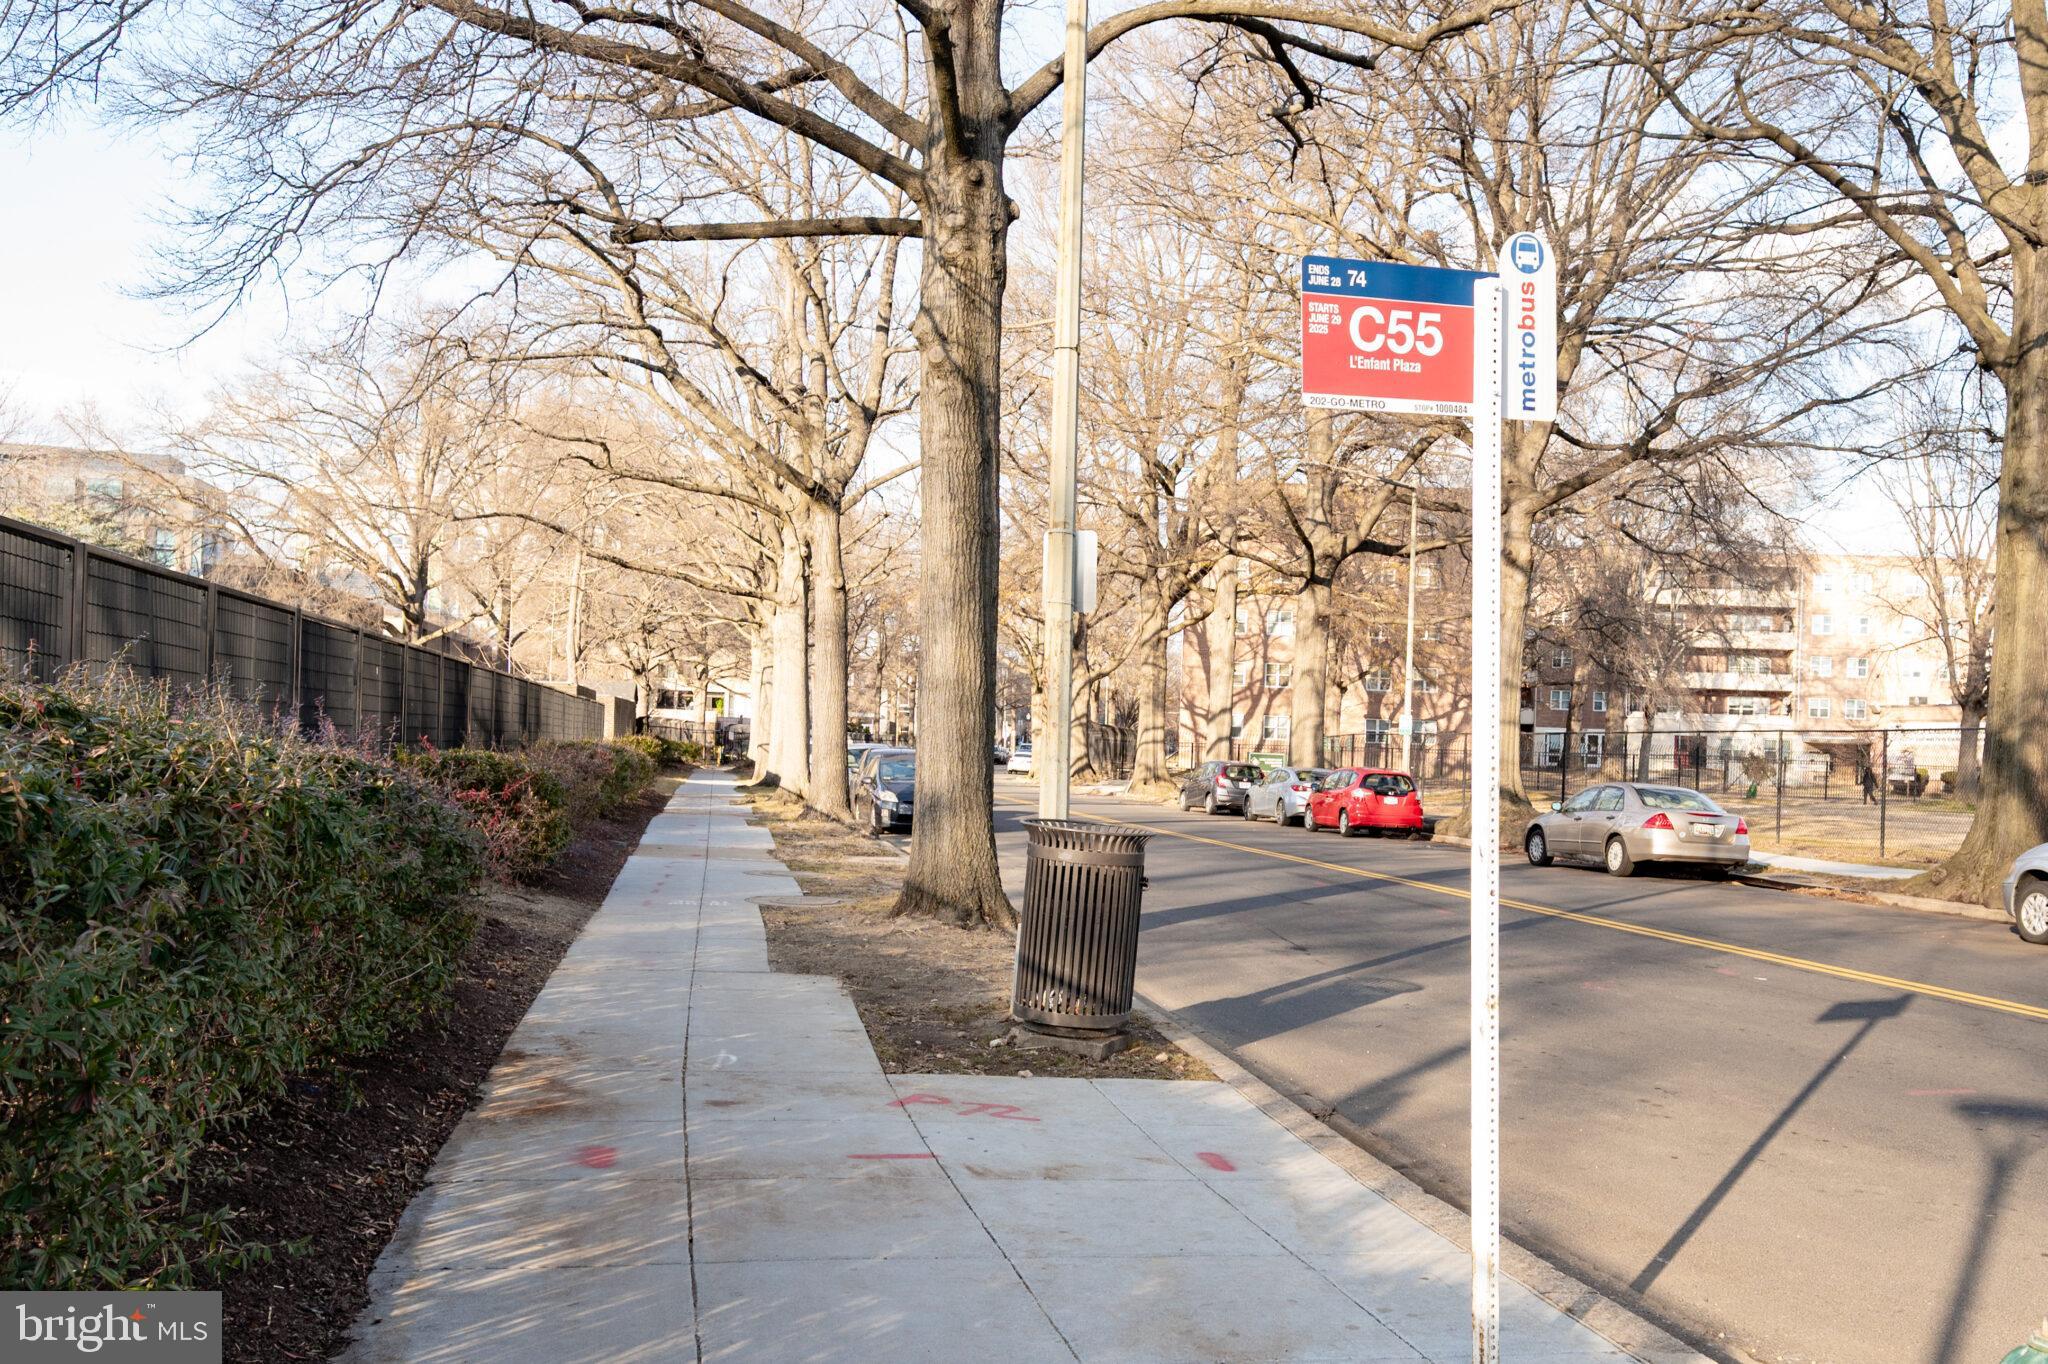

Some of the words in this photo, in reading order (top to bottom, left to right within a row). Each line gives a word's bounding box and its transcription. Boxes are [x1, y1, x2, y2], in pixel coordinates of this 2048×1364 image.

[1308, 264, 1330, 275] ENDS
[1308, 275, 1329, 286] JUNE
[1331, 277, 1342, 287] 28
[1347, 270, 1367, 287] 74
[1308, 302, 1339, 314] STARTS
[1308, 313, 1329, 323] JUNE
[1331, 315, 1342, 325] 29
[1308, 323, 1329, 334] 2025
[1349, 305, 1444, 356] C55
[1517, 281, 1536, 412] metrobus
[1349, 355, 1391, 371] L'Enfant
[1393, 358, 1422, 373] Plaza
[1310, 396, 1386, 409] 202-GO-METRO
